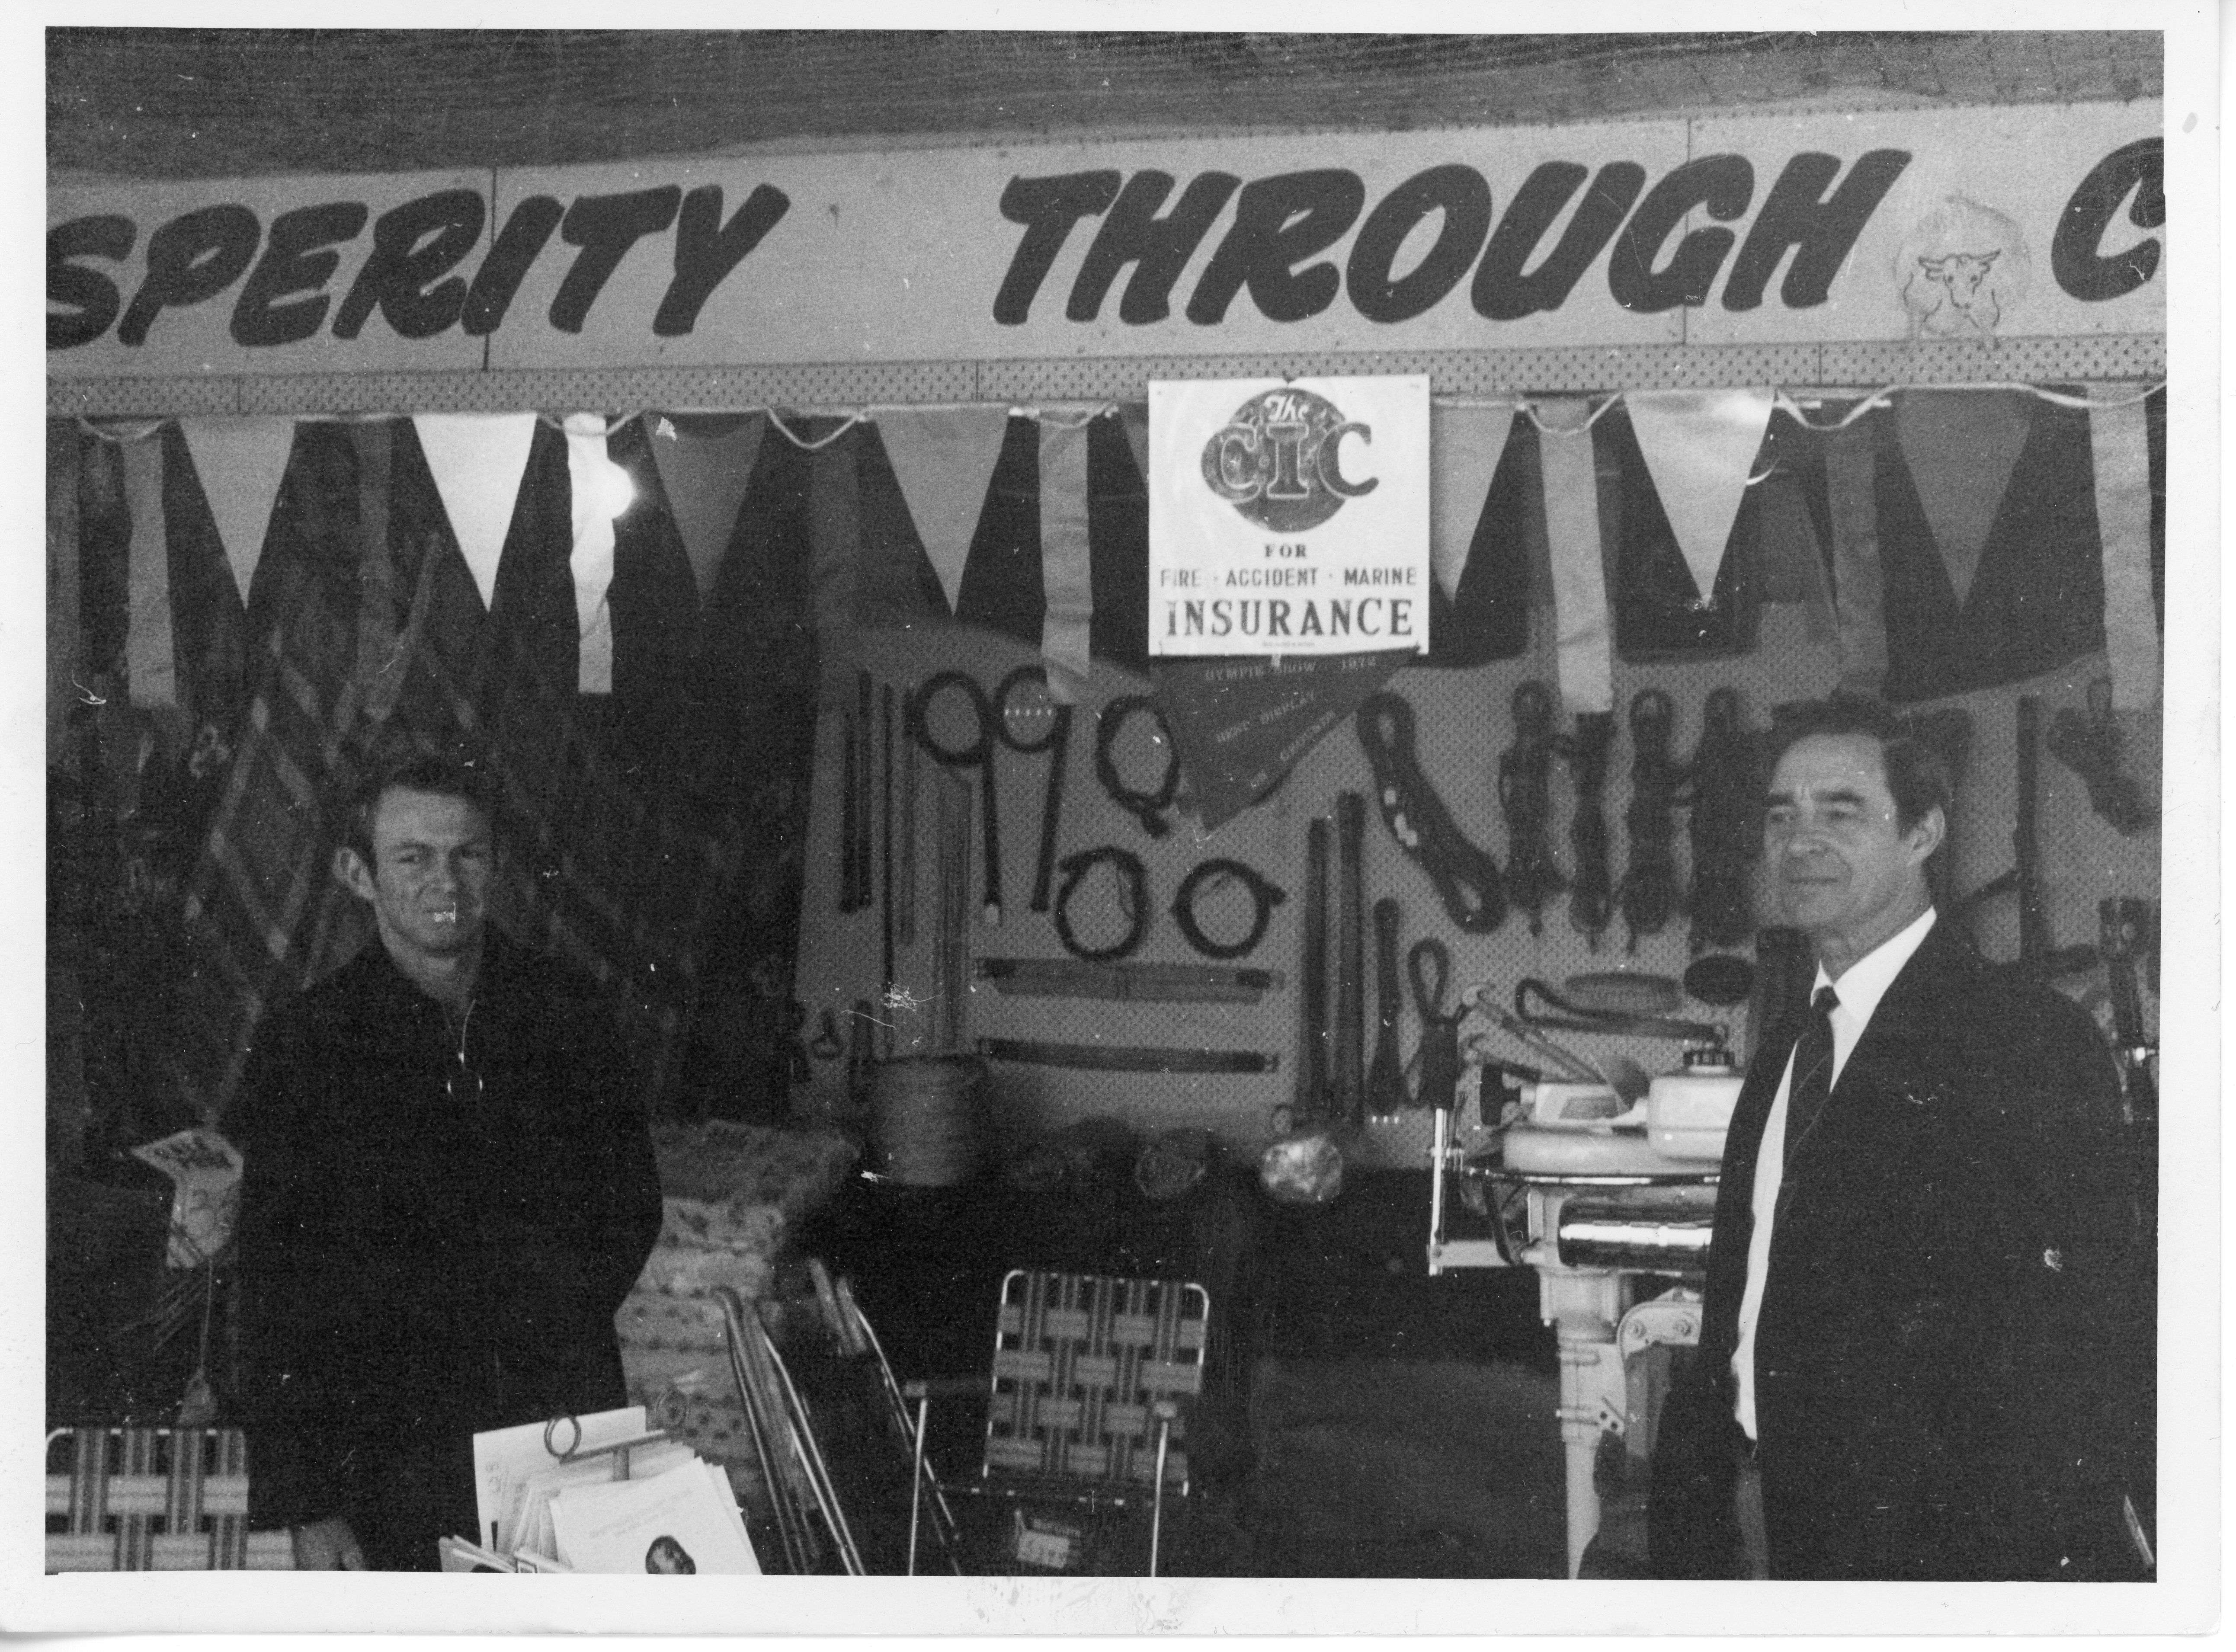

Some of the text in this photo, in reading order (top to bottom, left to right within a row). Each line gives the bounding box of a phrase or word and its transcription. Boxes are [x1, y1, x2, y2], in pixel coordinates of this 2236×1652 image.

[992, 148, 1913, 326] THROUGH
[1264, 394, 1309, 423] The
[1264, 544, 1307, 558] FOR
[1160, 566, 1417, 588] FIRE ACCIDENT MARINE
[1166, 597, 1413, 637] INSURANCE
